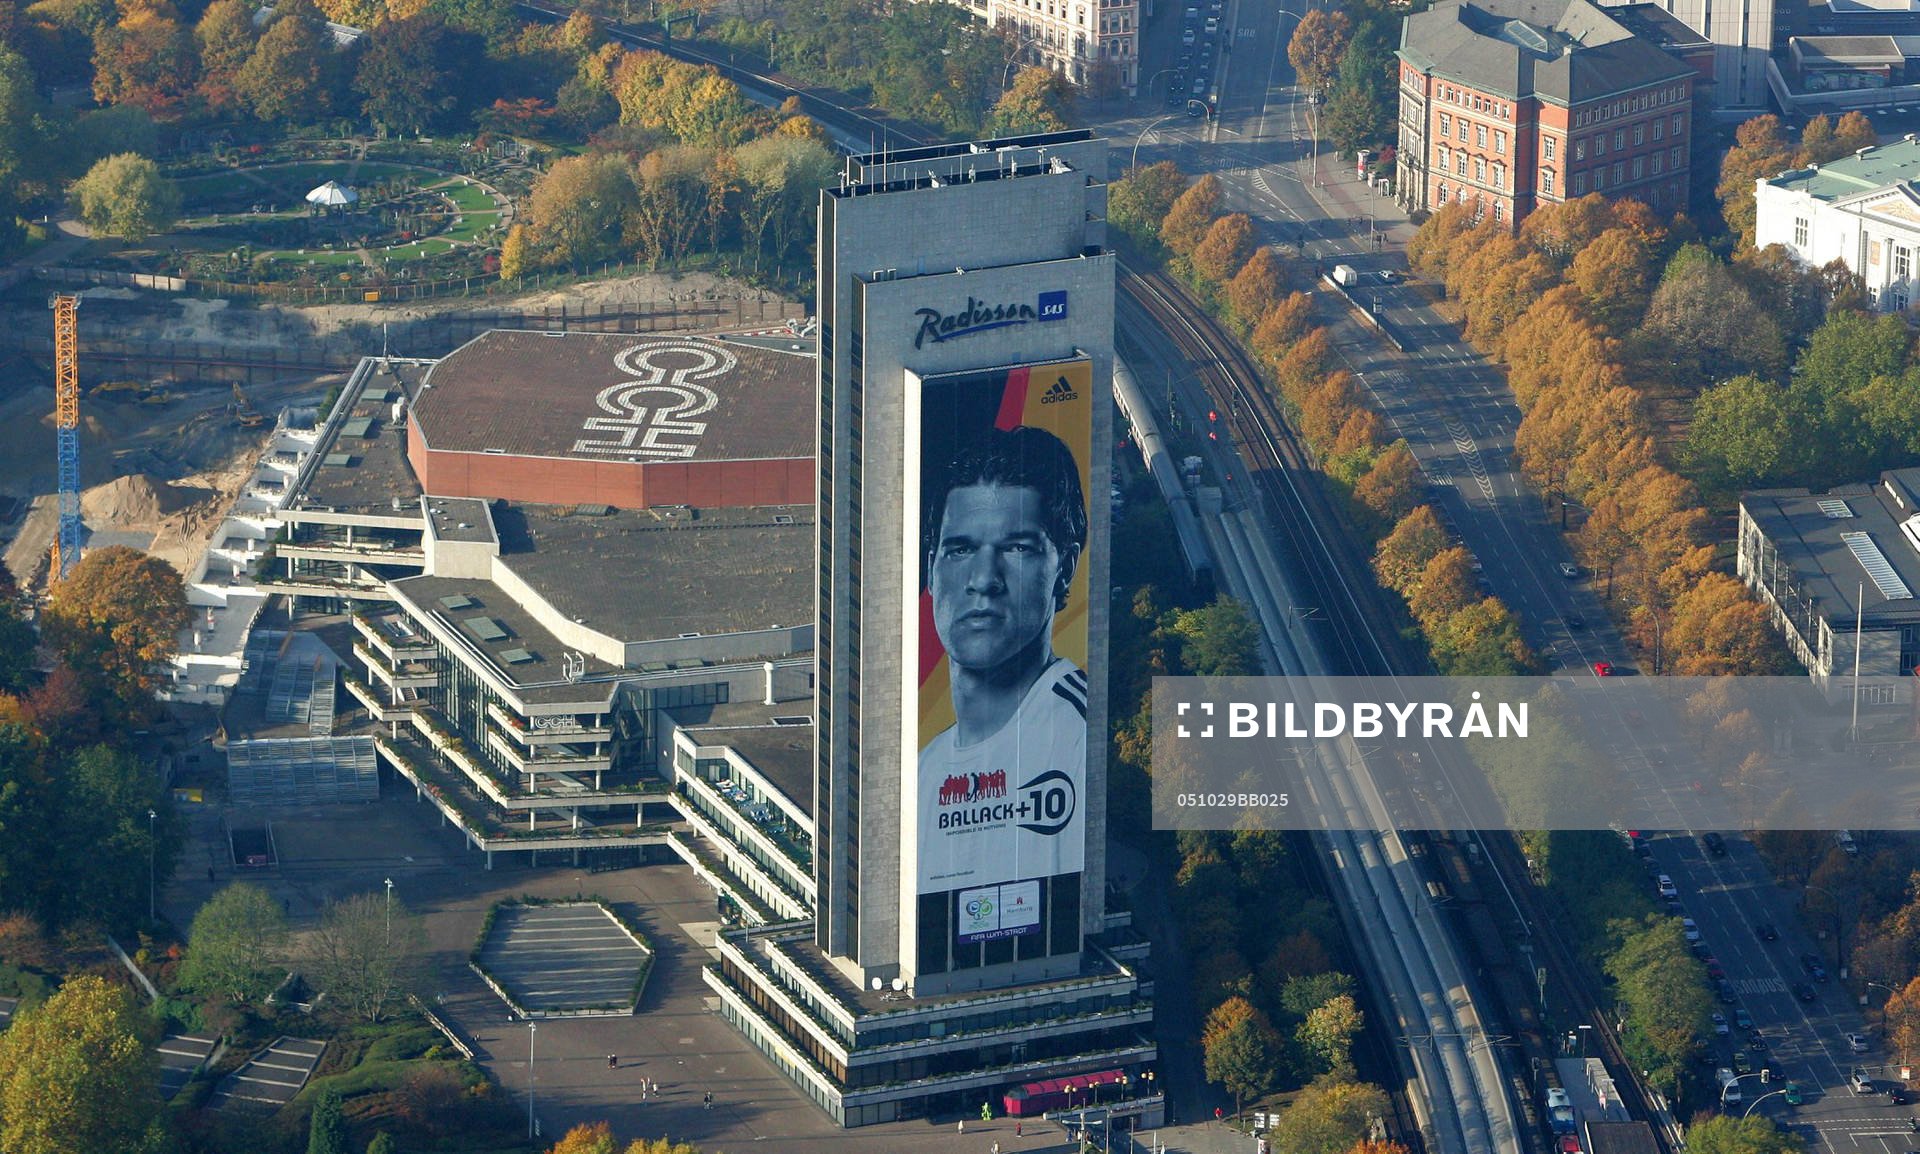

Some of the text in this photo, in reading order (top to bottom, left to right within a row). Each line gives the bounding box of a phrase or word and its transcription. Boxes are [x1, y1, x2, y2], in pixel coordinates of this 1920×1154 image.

[914, 296, 1065, 350] Radisson SAS
[572, 340, 738, 457] CCH
[1041, 391, 1079, 405] adidas
[534, 713, 576, 729] CCH
